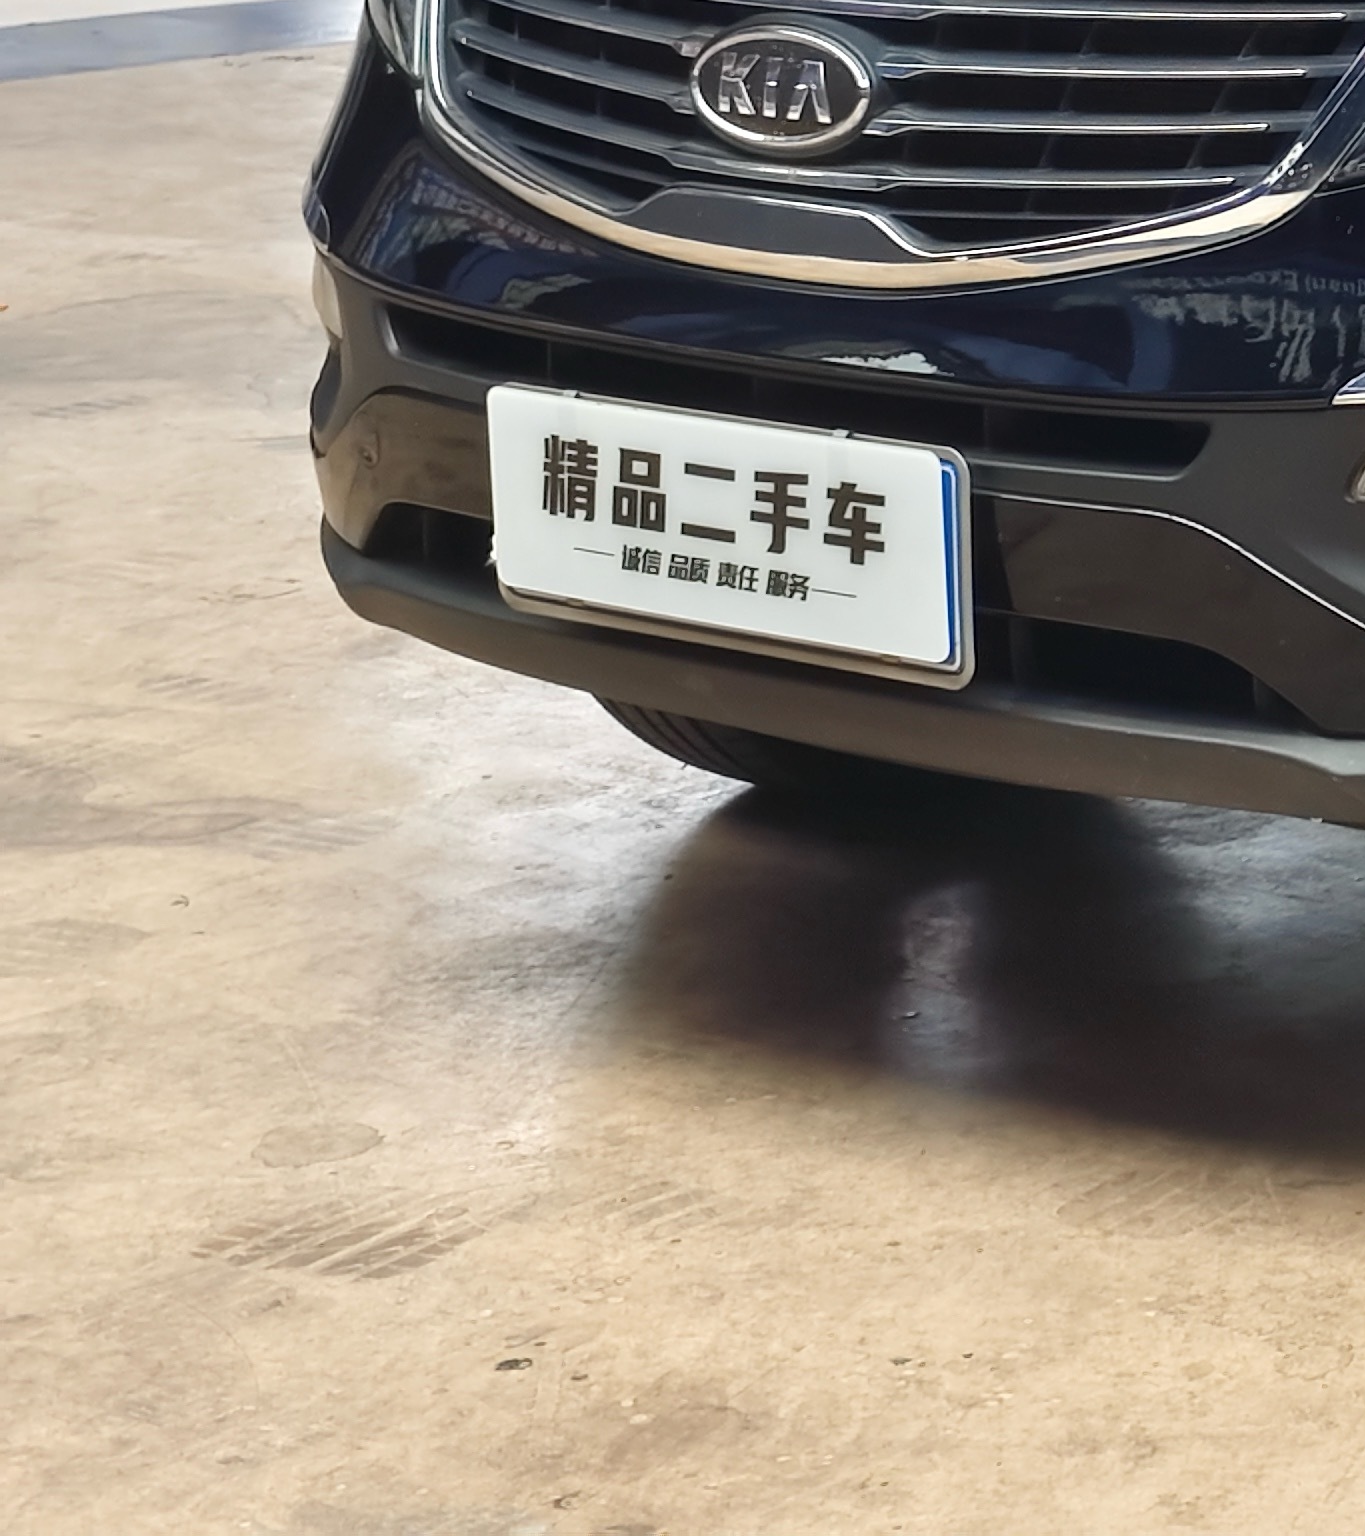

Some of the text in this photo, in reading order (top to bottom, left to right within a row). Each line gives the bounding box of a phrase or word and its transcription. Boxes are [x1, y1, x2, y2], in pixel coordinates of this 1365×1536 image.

[718, 52, 832, 124] KIA
[541, 434, 888, 566] 精品二手车
[621, 545, 811, 602] 诚信 品质 责任 服务
